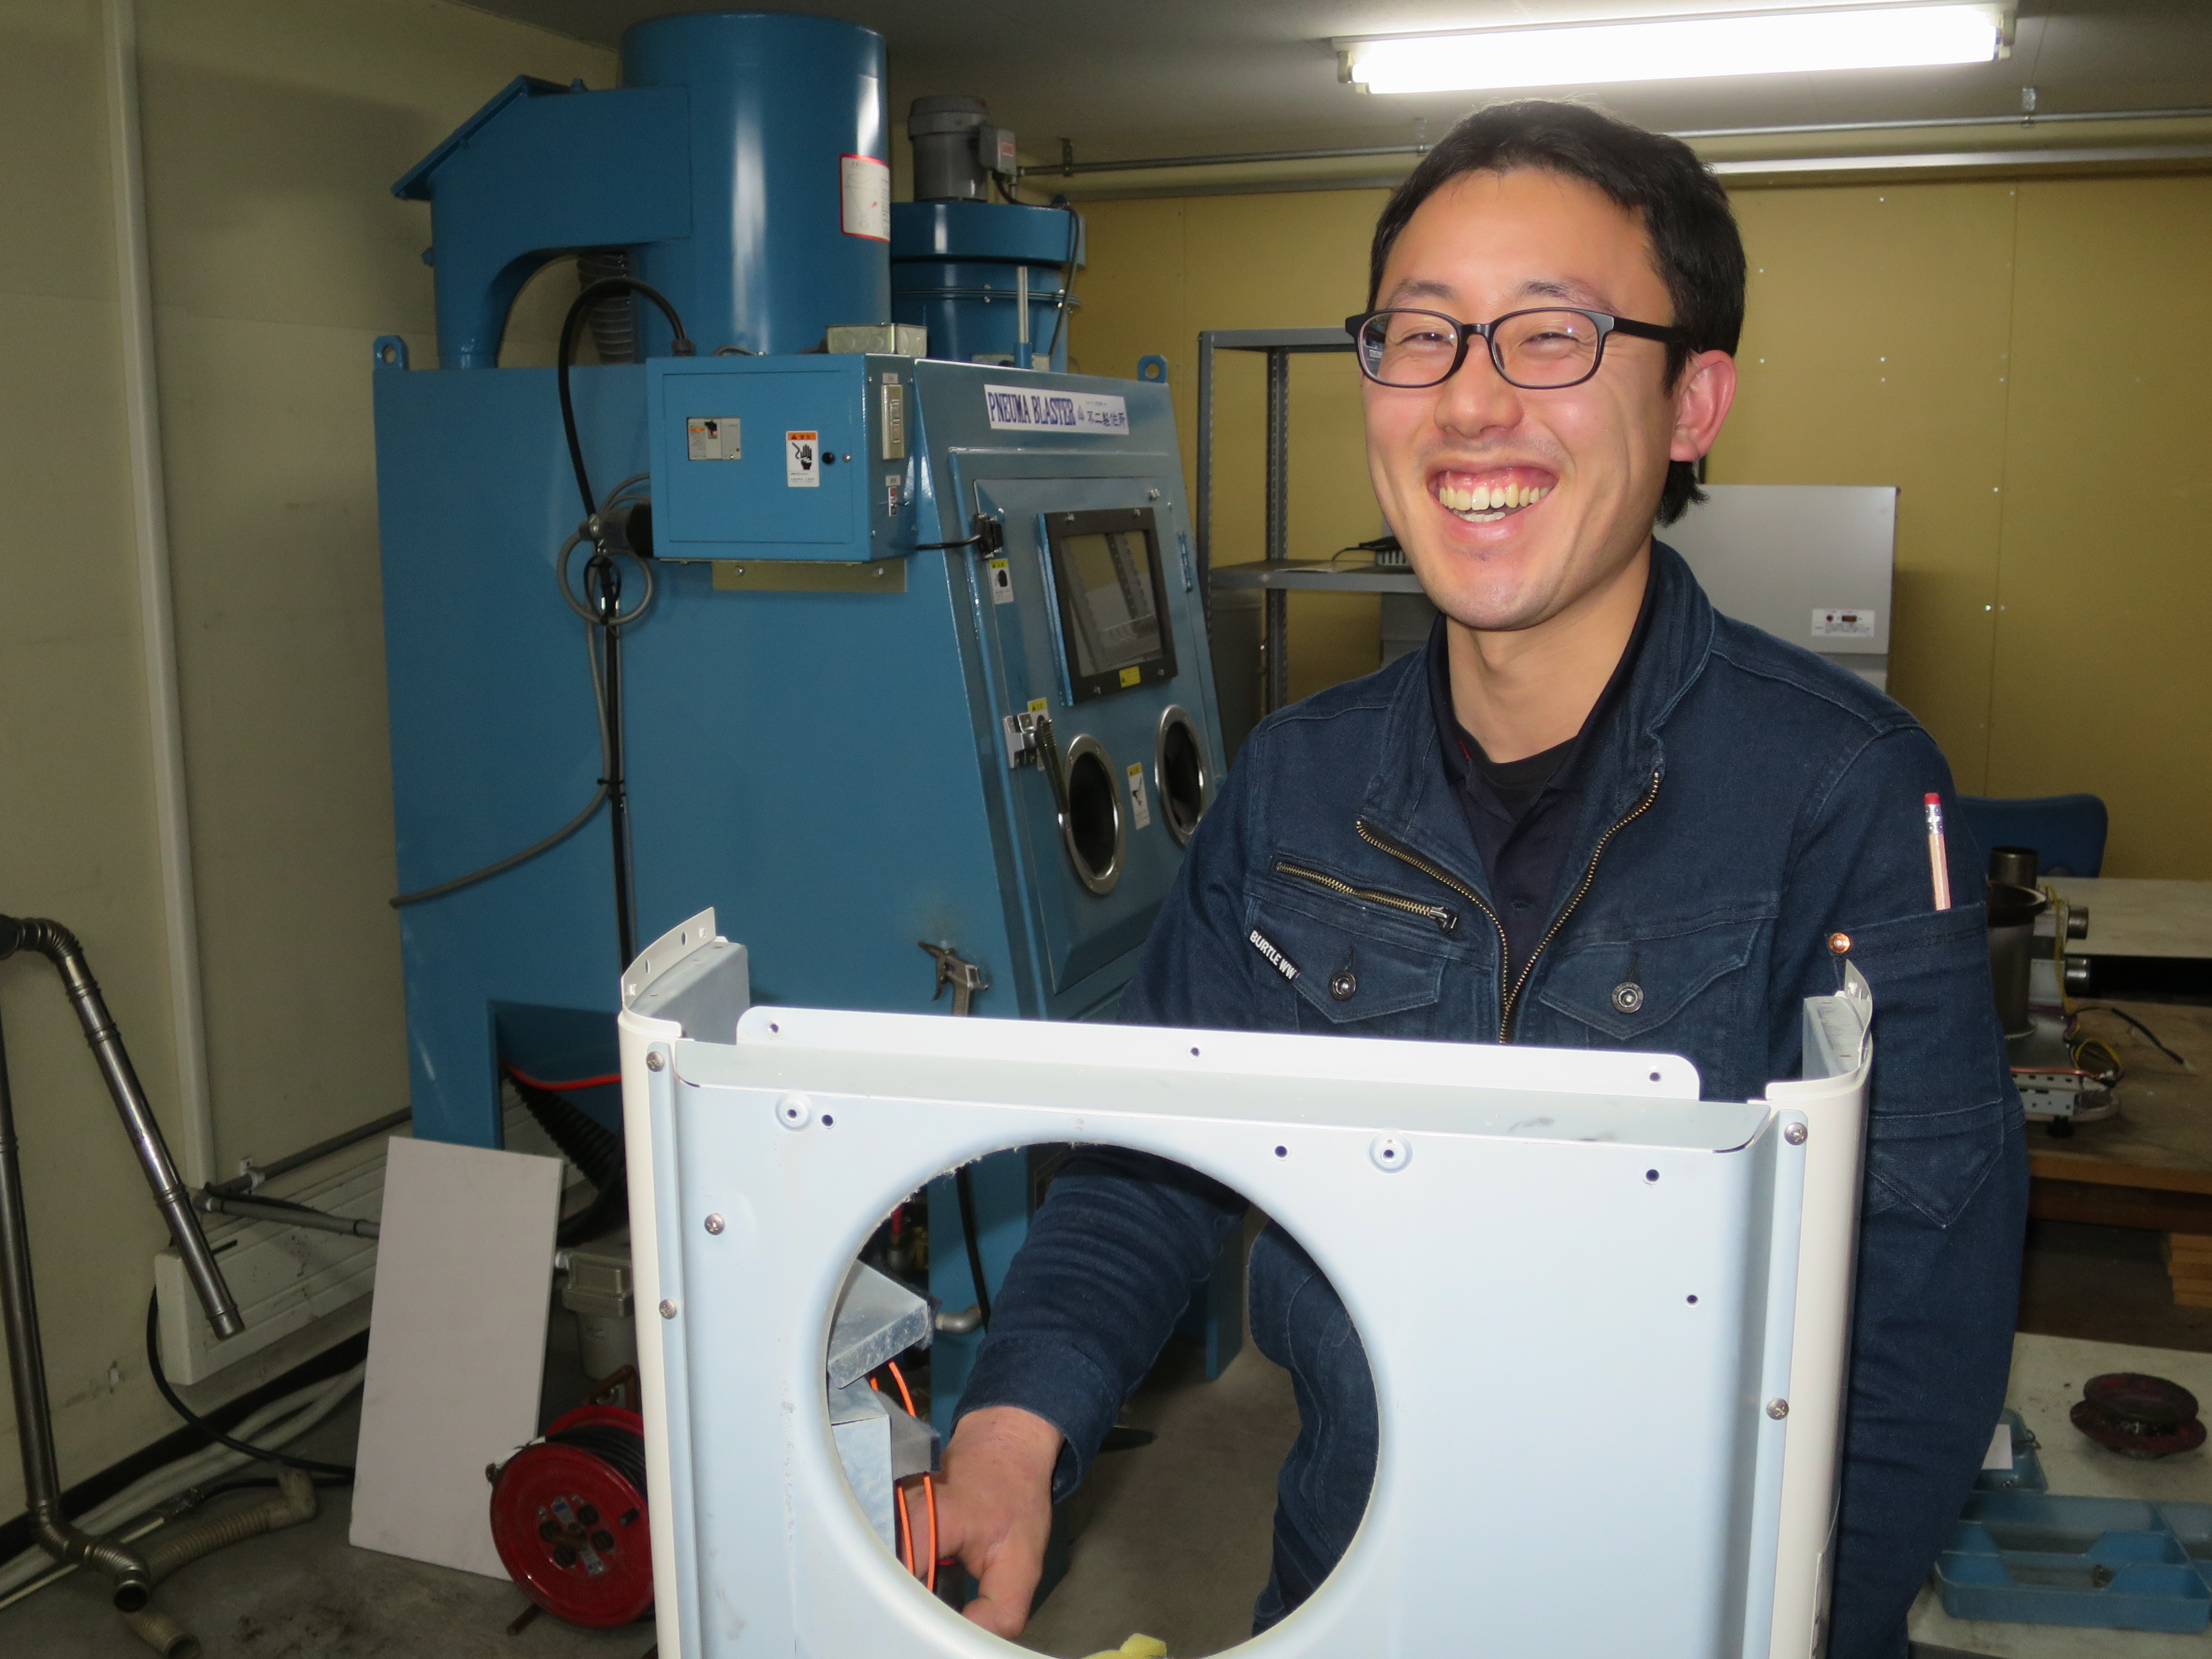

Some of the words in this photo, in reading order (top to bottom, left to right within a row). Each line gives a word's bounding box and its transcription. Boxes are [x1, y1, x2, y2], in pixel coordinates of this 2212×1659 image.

[987, 392, 1031, 423] PNEUMA
[1032, 395, 1076, 426] BLASTER
[1249, 930, 1281, 966] BURTLE
